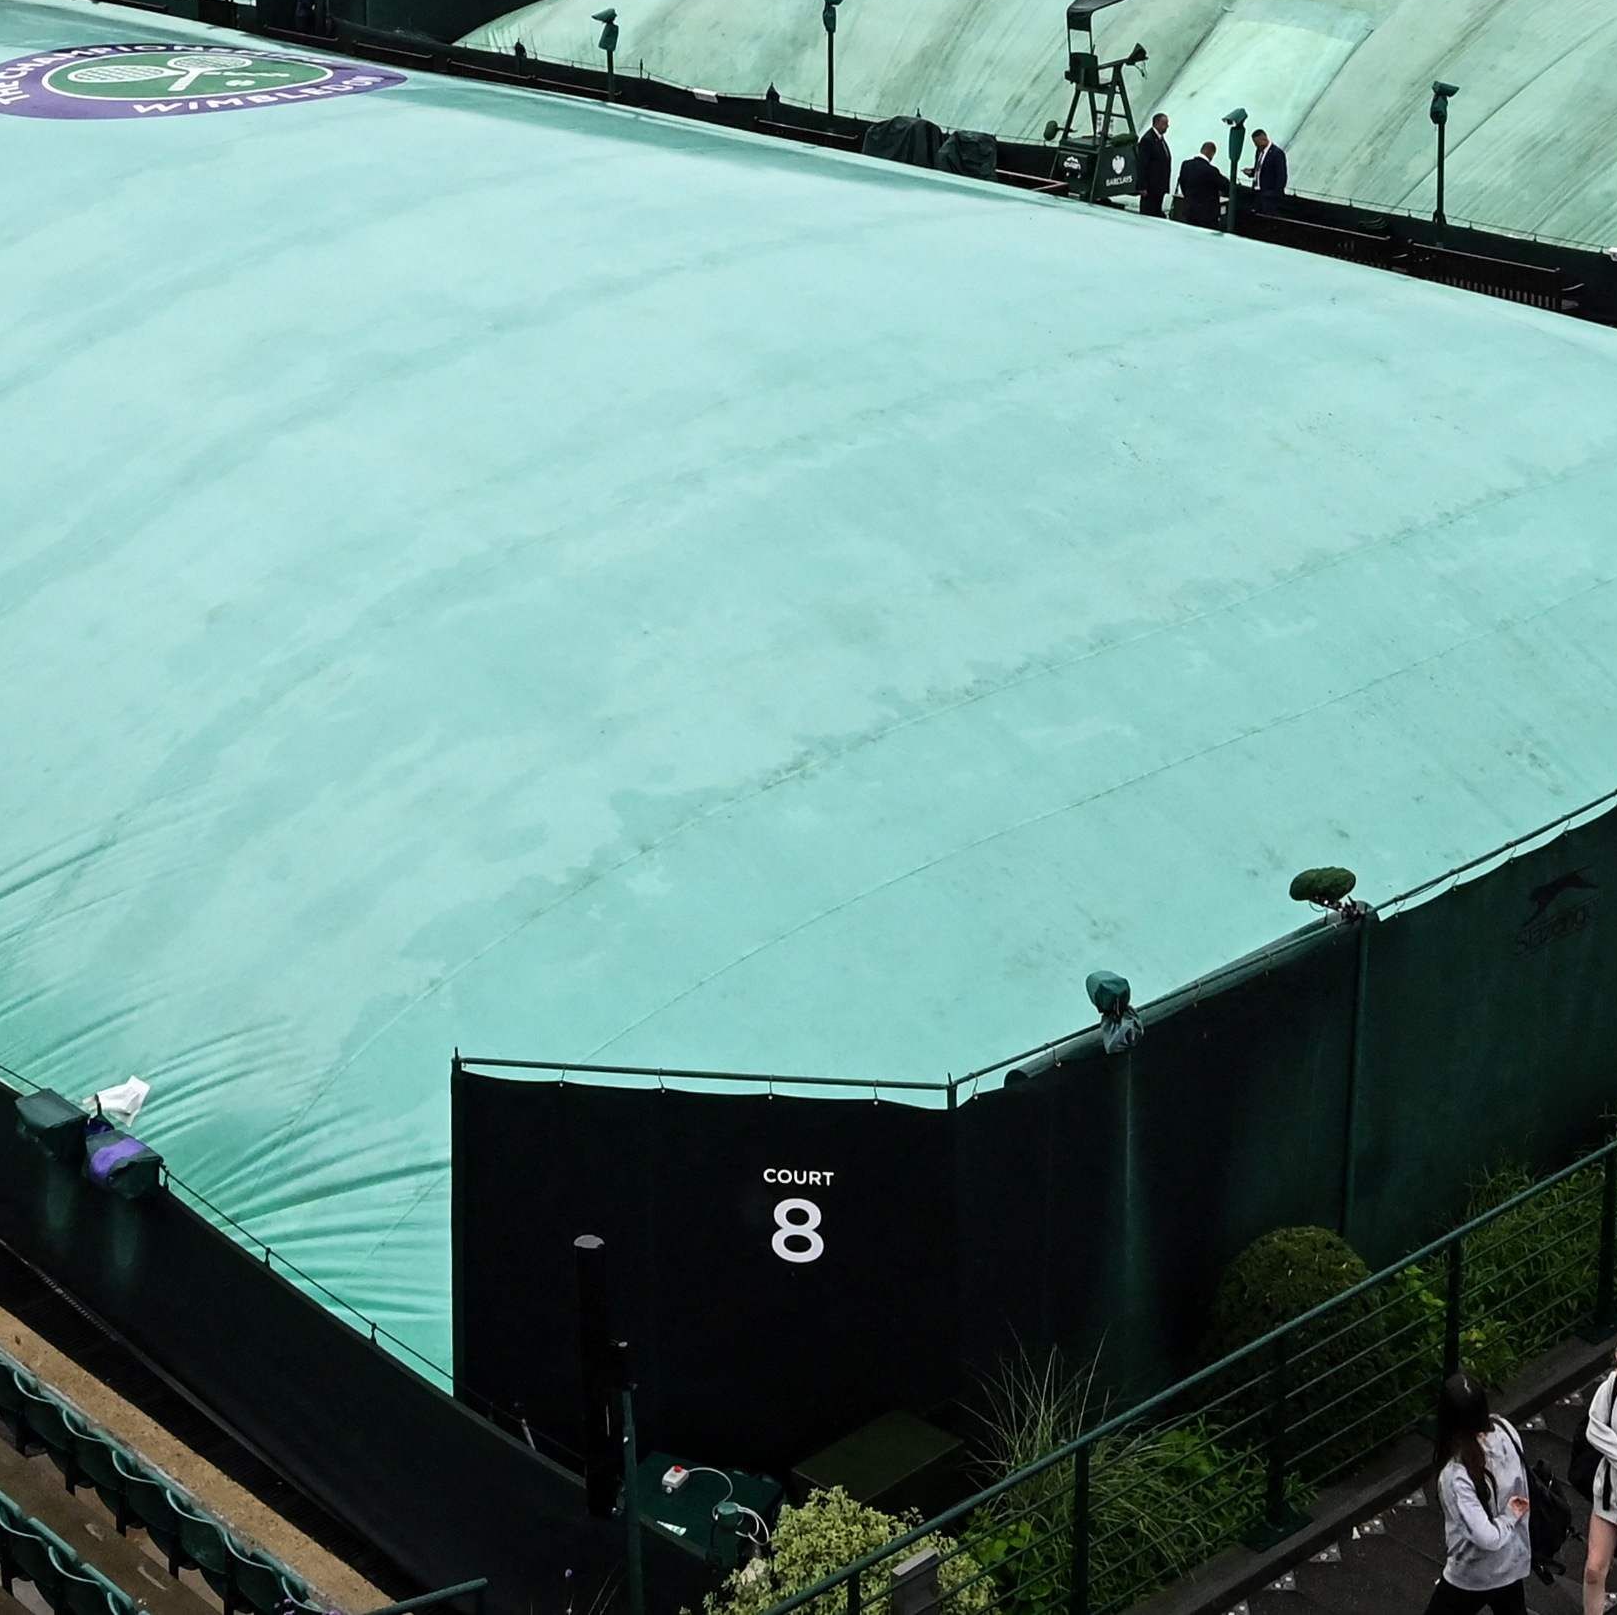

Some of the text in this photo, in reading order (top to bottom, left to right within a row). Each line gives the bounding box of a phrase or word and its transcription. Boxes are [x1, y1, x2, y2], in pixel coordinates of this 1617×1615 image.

[1105, 175, 1134, 187] BARCLAYS
[763, 1168, 834, 1187] COURT
[771, 1198, 824, 1263] 8
